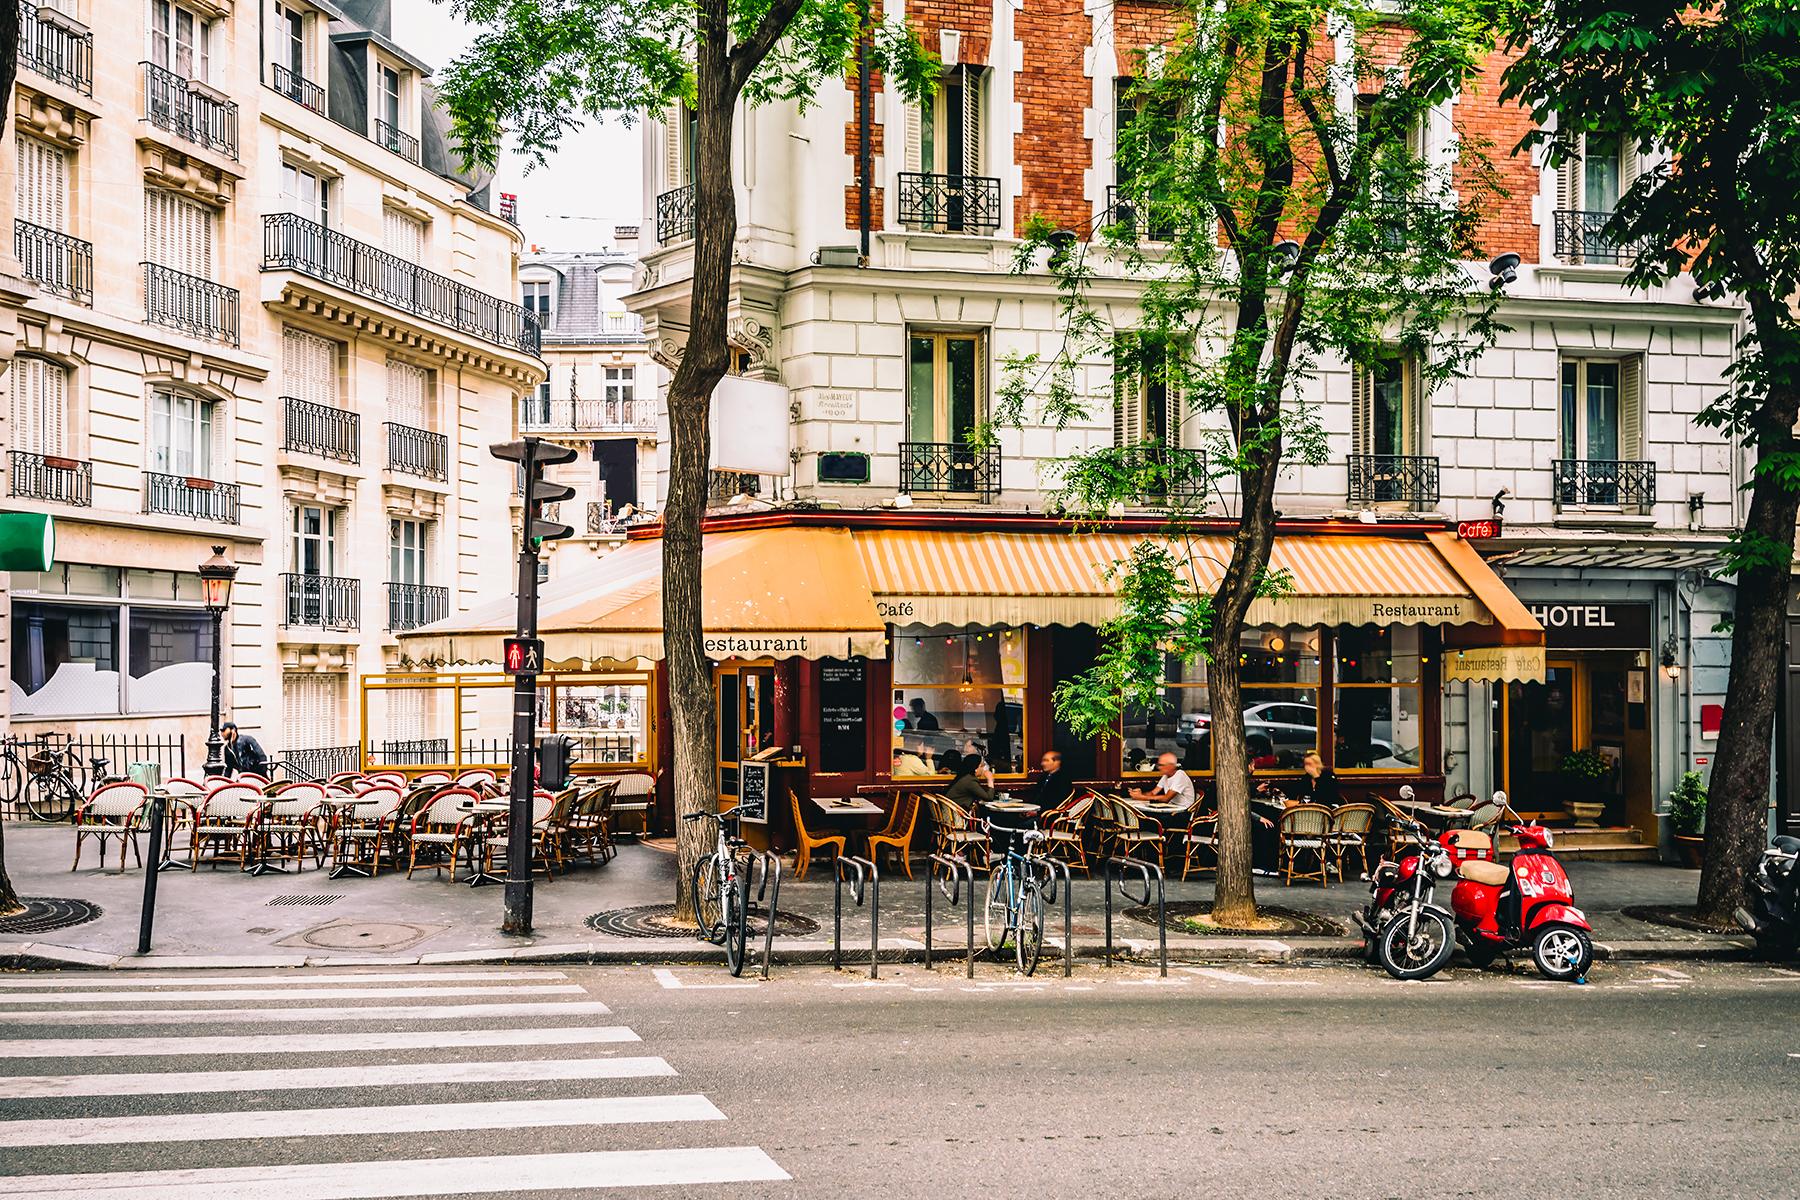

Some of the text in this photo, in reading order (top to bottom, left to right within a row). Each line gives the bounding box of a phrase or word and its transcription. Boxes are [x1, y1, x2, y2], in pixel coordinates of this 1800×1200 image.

[1458, 521, 1489, 537] Café
[876, 601, 914, 617] Café
[1372, 603, 1461, 617] Restaurant
[1531, 605, 1616, 627] HOTEL
[704, 636, 808, 652] estaurant
